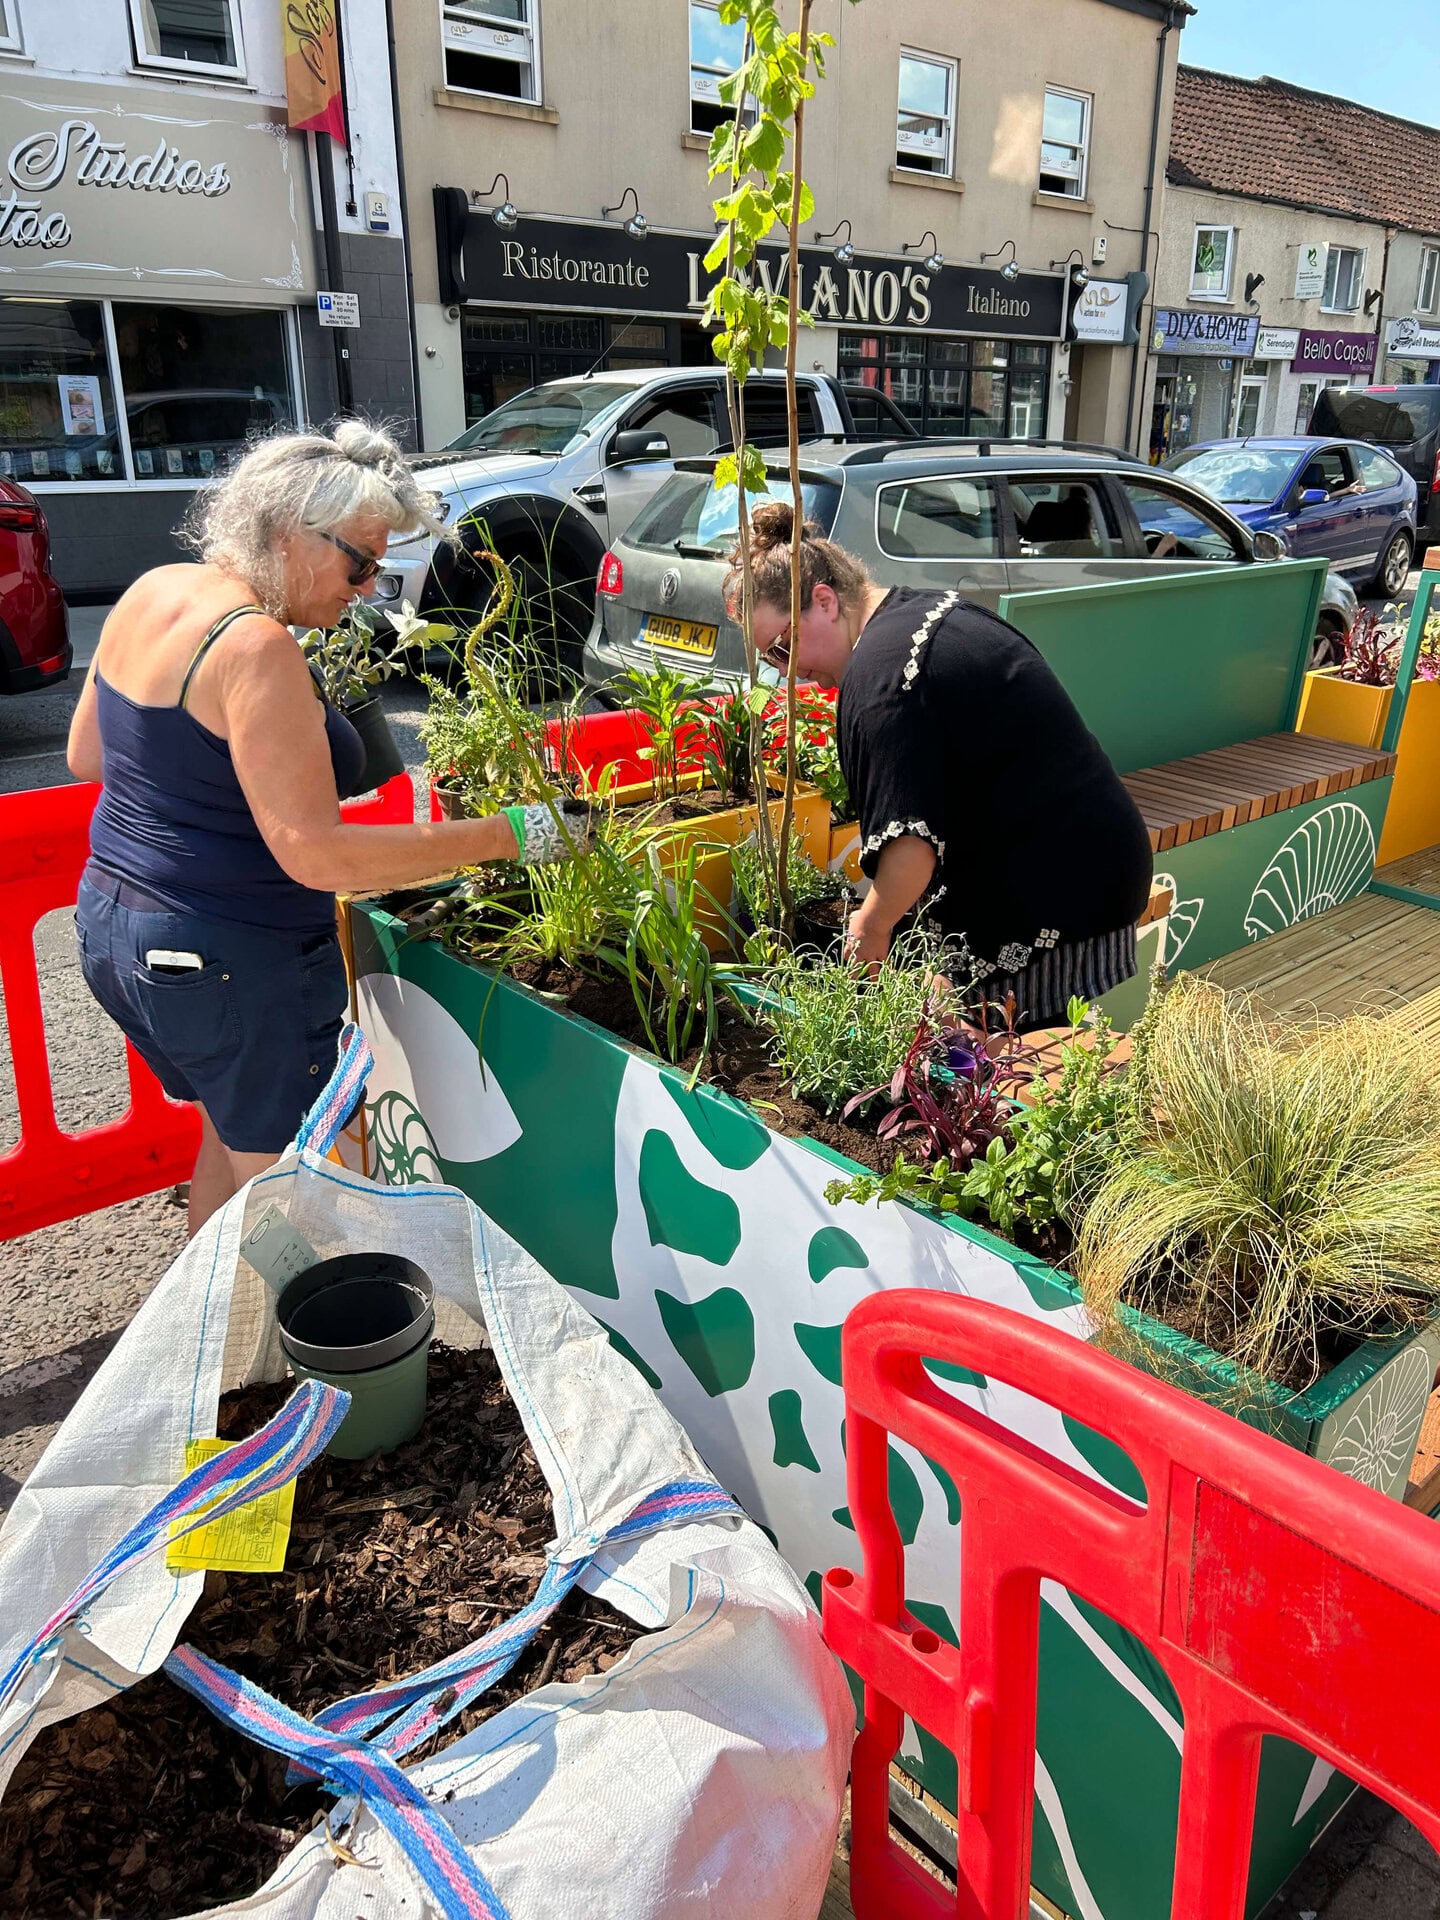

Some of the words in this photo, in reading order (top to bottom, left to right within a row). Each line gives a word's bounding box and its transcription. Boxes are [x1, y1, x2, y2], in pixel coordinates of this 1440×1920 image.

[8, 119, 231, 197] Studios
[501, 239, 650, 289] Ristorante
[967, 285, 1031, 317] Italiano
[1266, 339, 1296, 350] Serendipity
[1303, 338, 1331, 360] Bello
